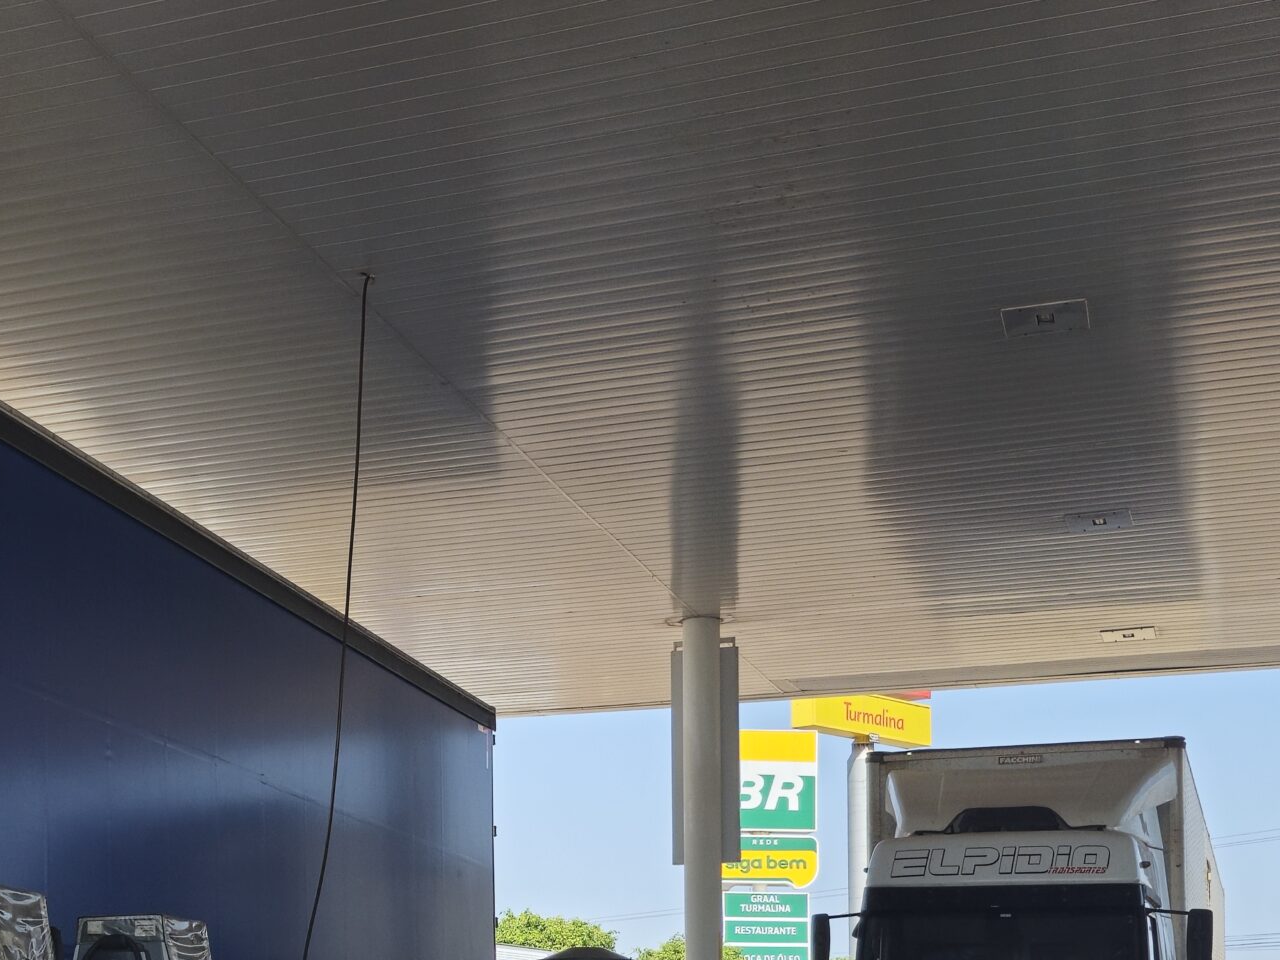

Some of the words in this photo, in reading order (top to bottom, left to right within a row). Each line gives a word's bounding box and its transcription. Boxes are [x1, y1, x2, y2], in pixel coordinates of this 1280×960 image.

[843, 701, 904, 731] Turmalina
[740, 774, 803, 811] BR
[766, 855, 807, 869] bem
[1048, 866, 1106, 874] TRANSPORTES
[750, 895, 780, 903] GRAAL
[740, 904, 791, 912] TURMALINA
[735, 926, 796, 935] RESTAURANTE
